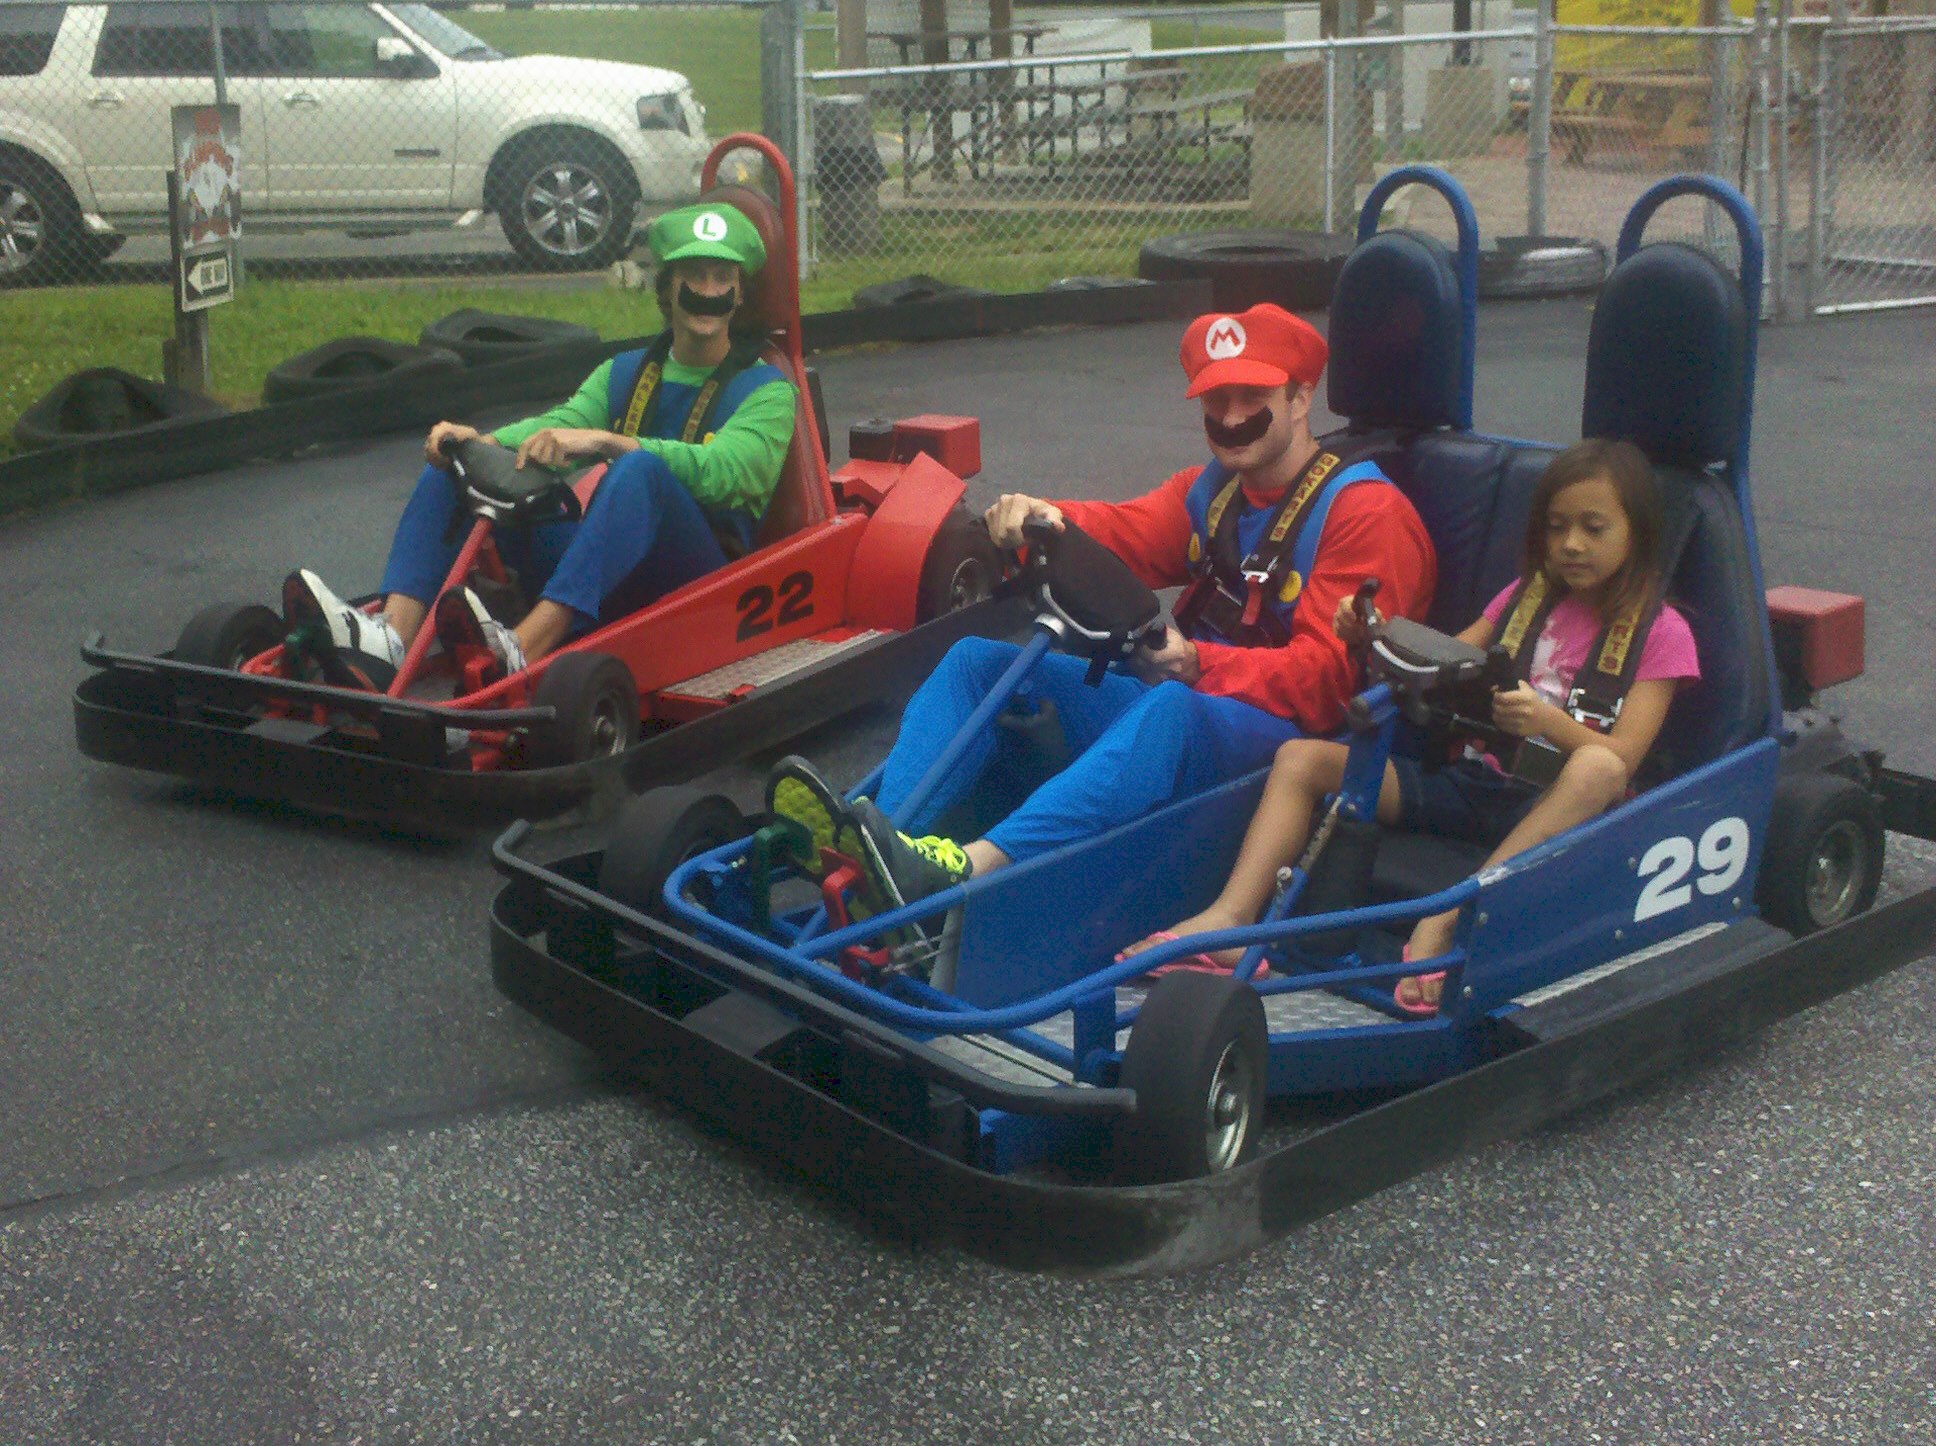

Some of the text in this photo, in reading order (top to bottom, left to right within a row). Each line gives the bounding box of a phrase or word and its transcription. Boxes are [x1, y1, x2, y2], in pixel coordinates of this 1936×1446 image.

[702, 217, 717, 237] L
[1210, 327, 1241, 351] M
[735, 569, 814, 644] 22
[1633, 816, 1750, 922] 29
